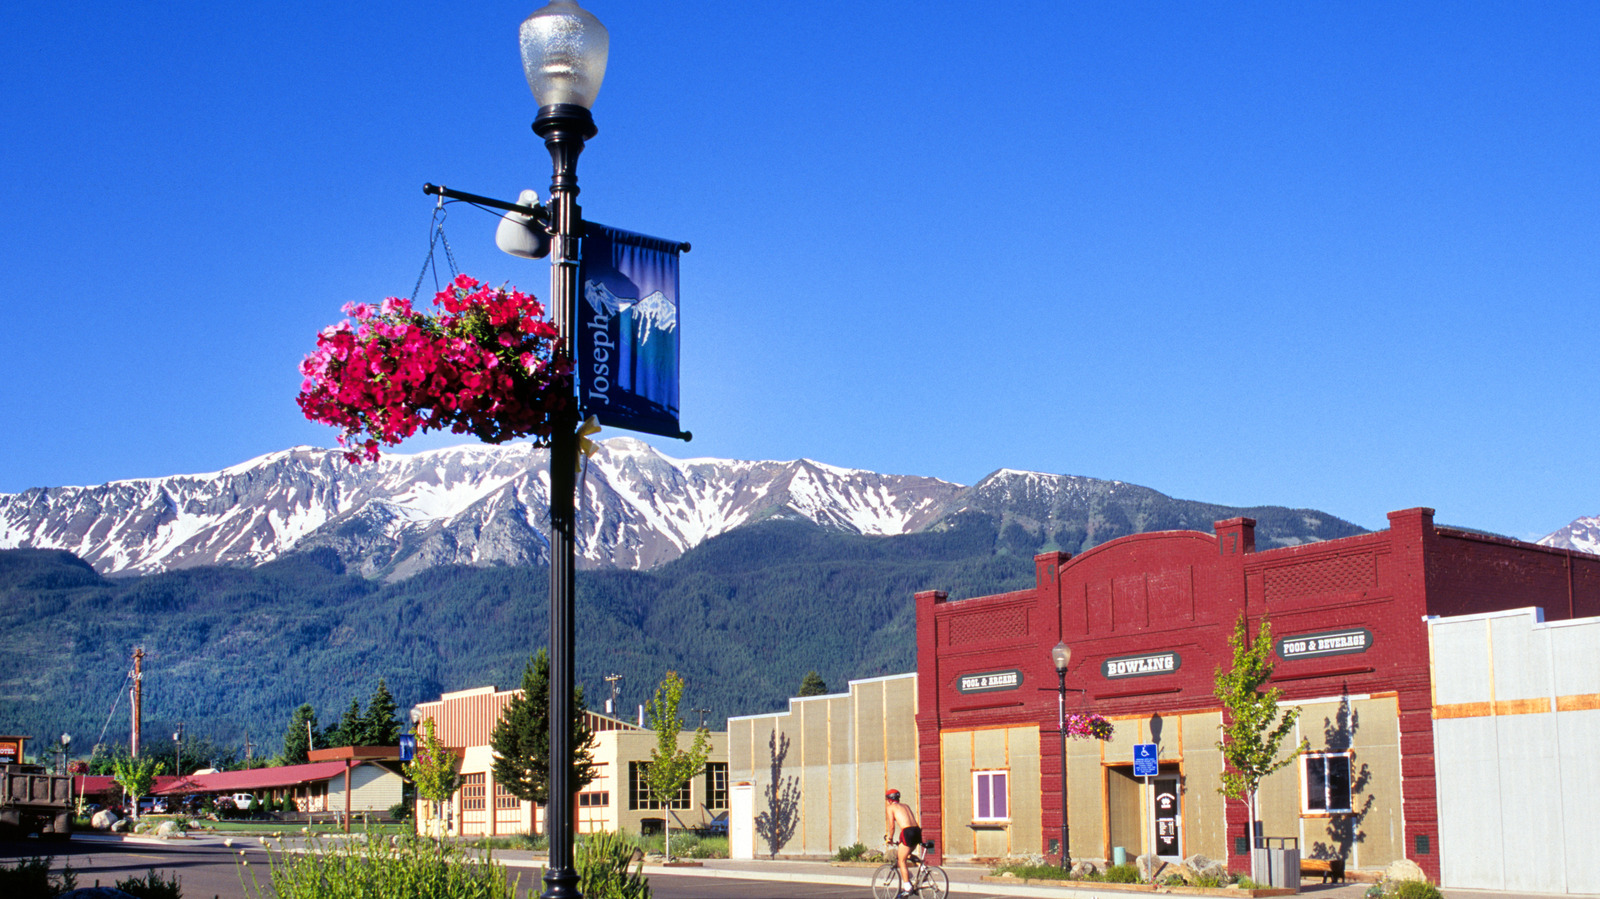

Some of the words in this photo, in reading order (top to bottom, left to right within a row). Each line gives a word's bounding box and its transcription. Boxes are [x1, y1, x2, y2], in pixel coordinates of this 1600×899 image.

[587, 314, 615, 405] Joseph
[1220, 532, 1238, 555] 17
[1039, 564, 1054, 585] 19
[1283, 641, 1306, 654] FOOD
[1308, 640, 1316, 651] &
[1318, 634, 1365, 650] BEVERAGE
[1107, 656, 1174, 675] BOWLING
[962, 678, 980, 688] POOL
[981, 677, 987, 686] &
[988, 674, 1017, 686] ARCADE
